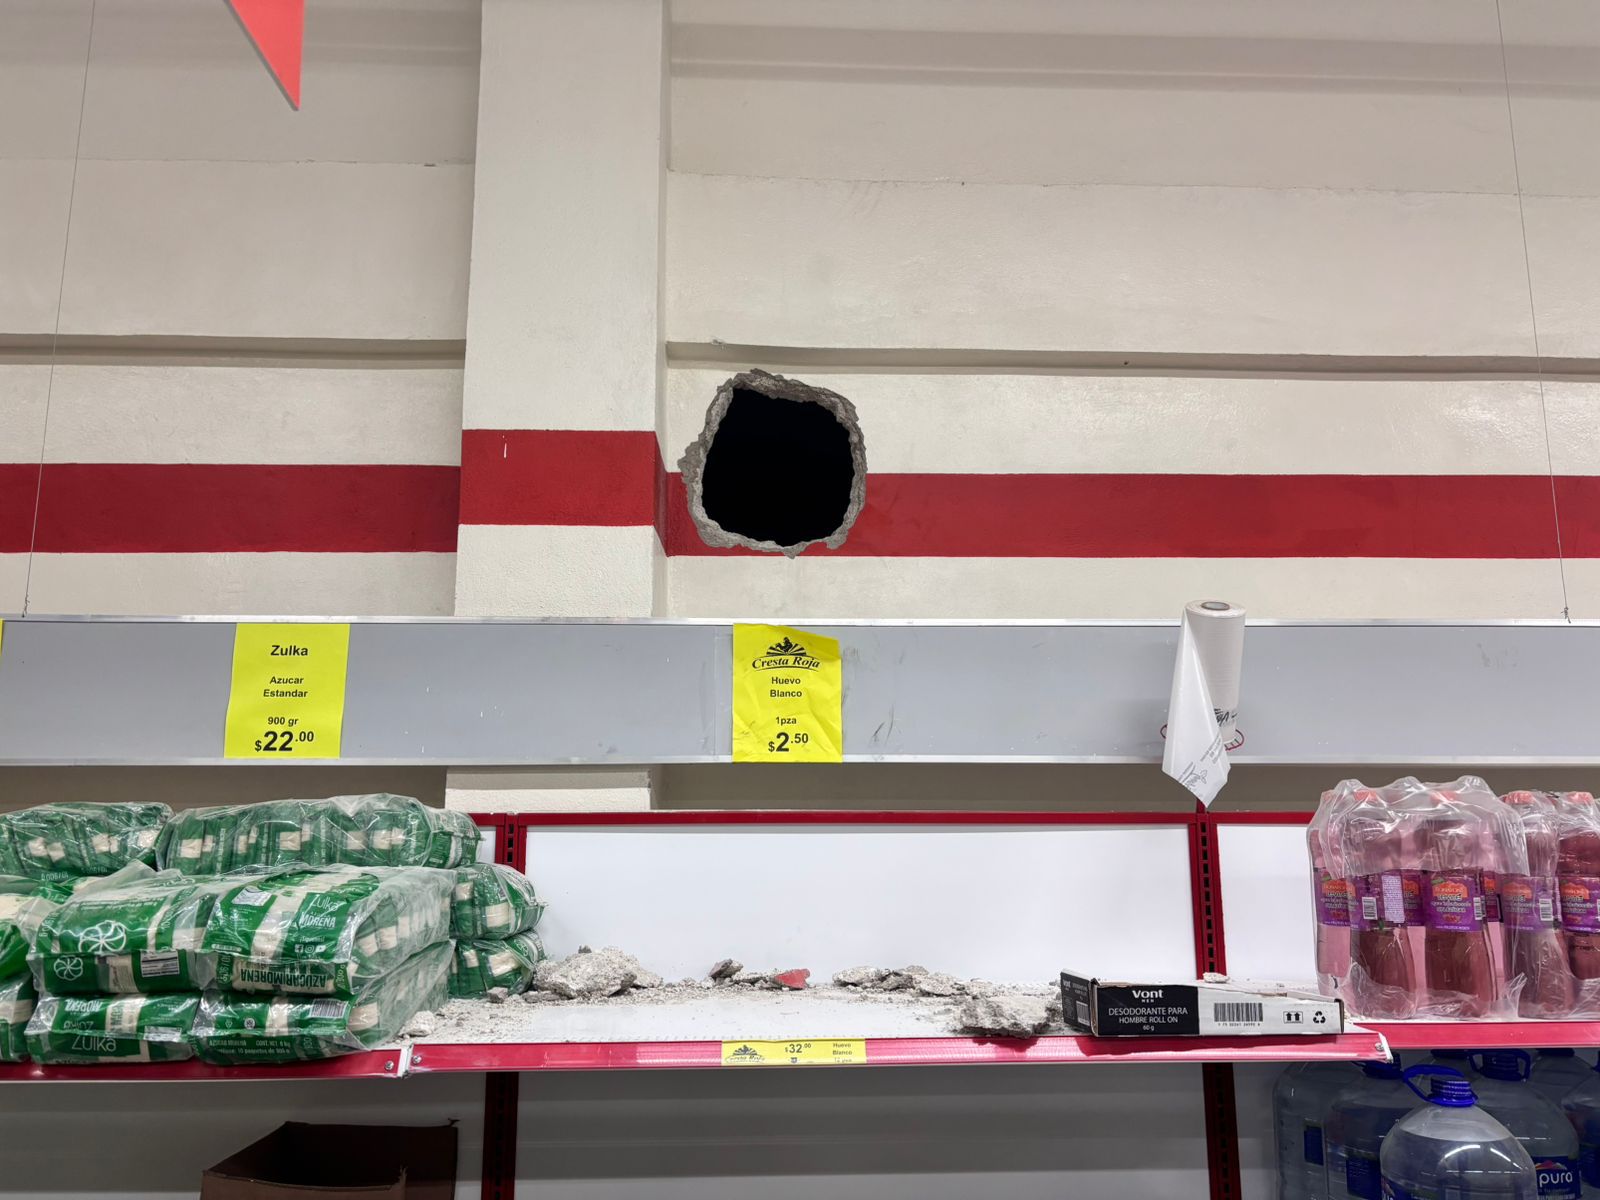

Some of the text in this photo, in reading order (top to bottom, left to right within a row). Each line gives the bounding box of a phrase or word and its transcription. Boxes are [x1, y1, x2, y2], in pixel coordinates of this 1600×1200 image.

[270, 644, 309, 656] Zulka
[752, 656, 820, 669] Cresta Roja
[269, 676, 304, 685] Azucar
[771, 677, 801, 685] Huevo
[263, 689, 308, 698] Estandar
[770, 690, 802, 698] Blanco
[267, 717, 298, 727] 900 gr
[775, 717, 797, 727] 1pza
[254, 731, 315, 752] $22.00
[768, 732, 809, 753] $2.50
[311, 894, 340, 911] Zulka
[299, 912, 336, 928] MORENA
[240, 969, 283, 984] MORENA
[1132, 989, 1163, 998] Vont
[1108, 1007, 1188, 1016] DESODORANTE PARA
[1119, 1016, 1147, 1024] HOMBRE
[72, 1033, 117, 1051] Zulka
